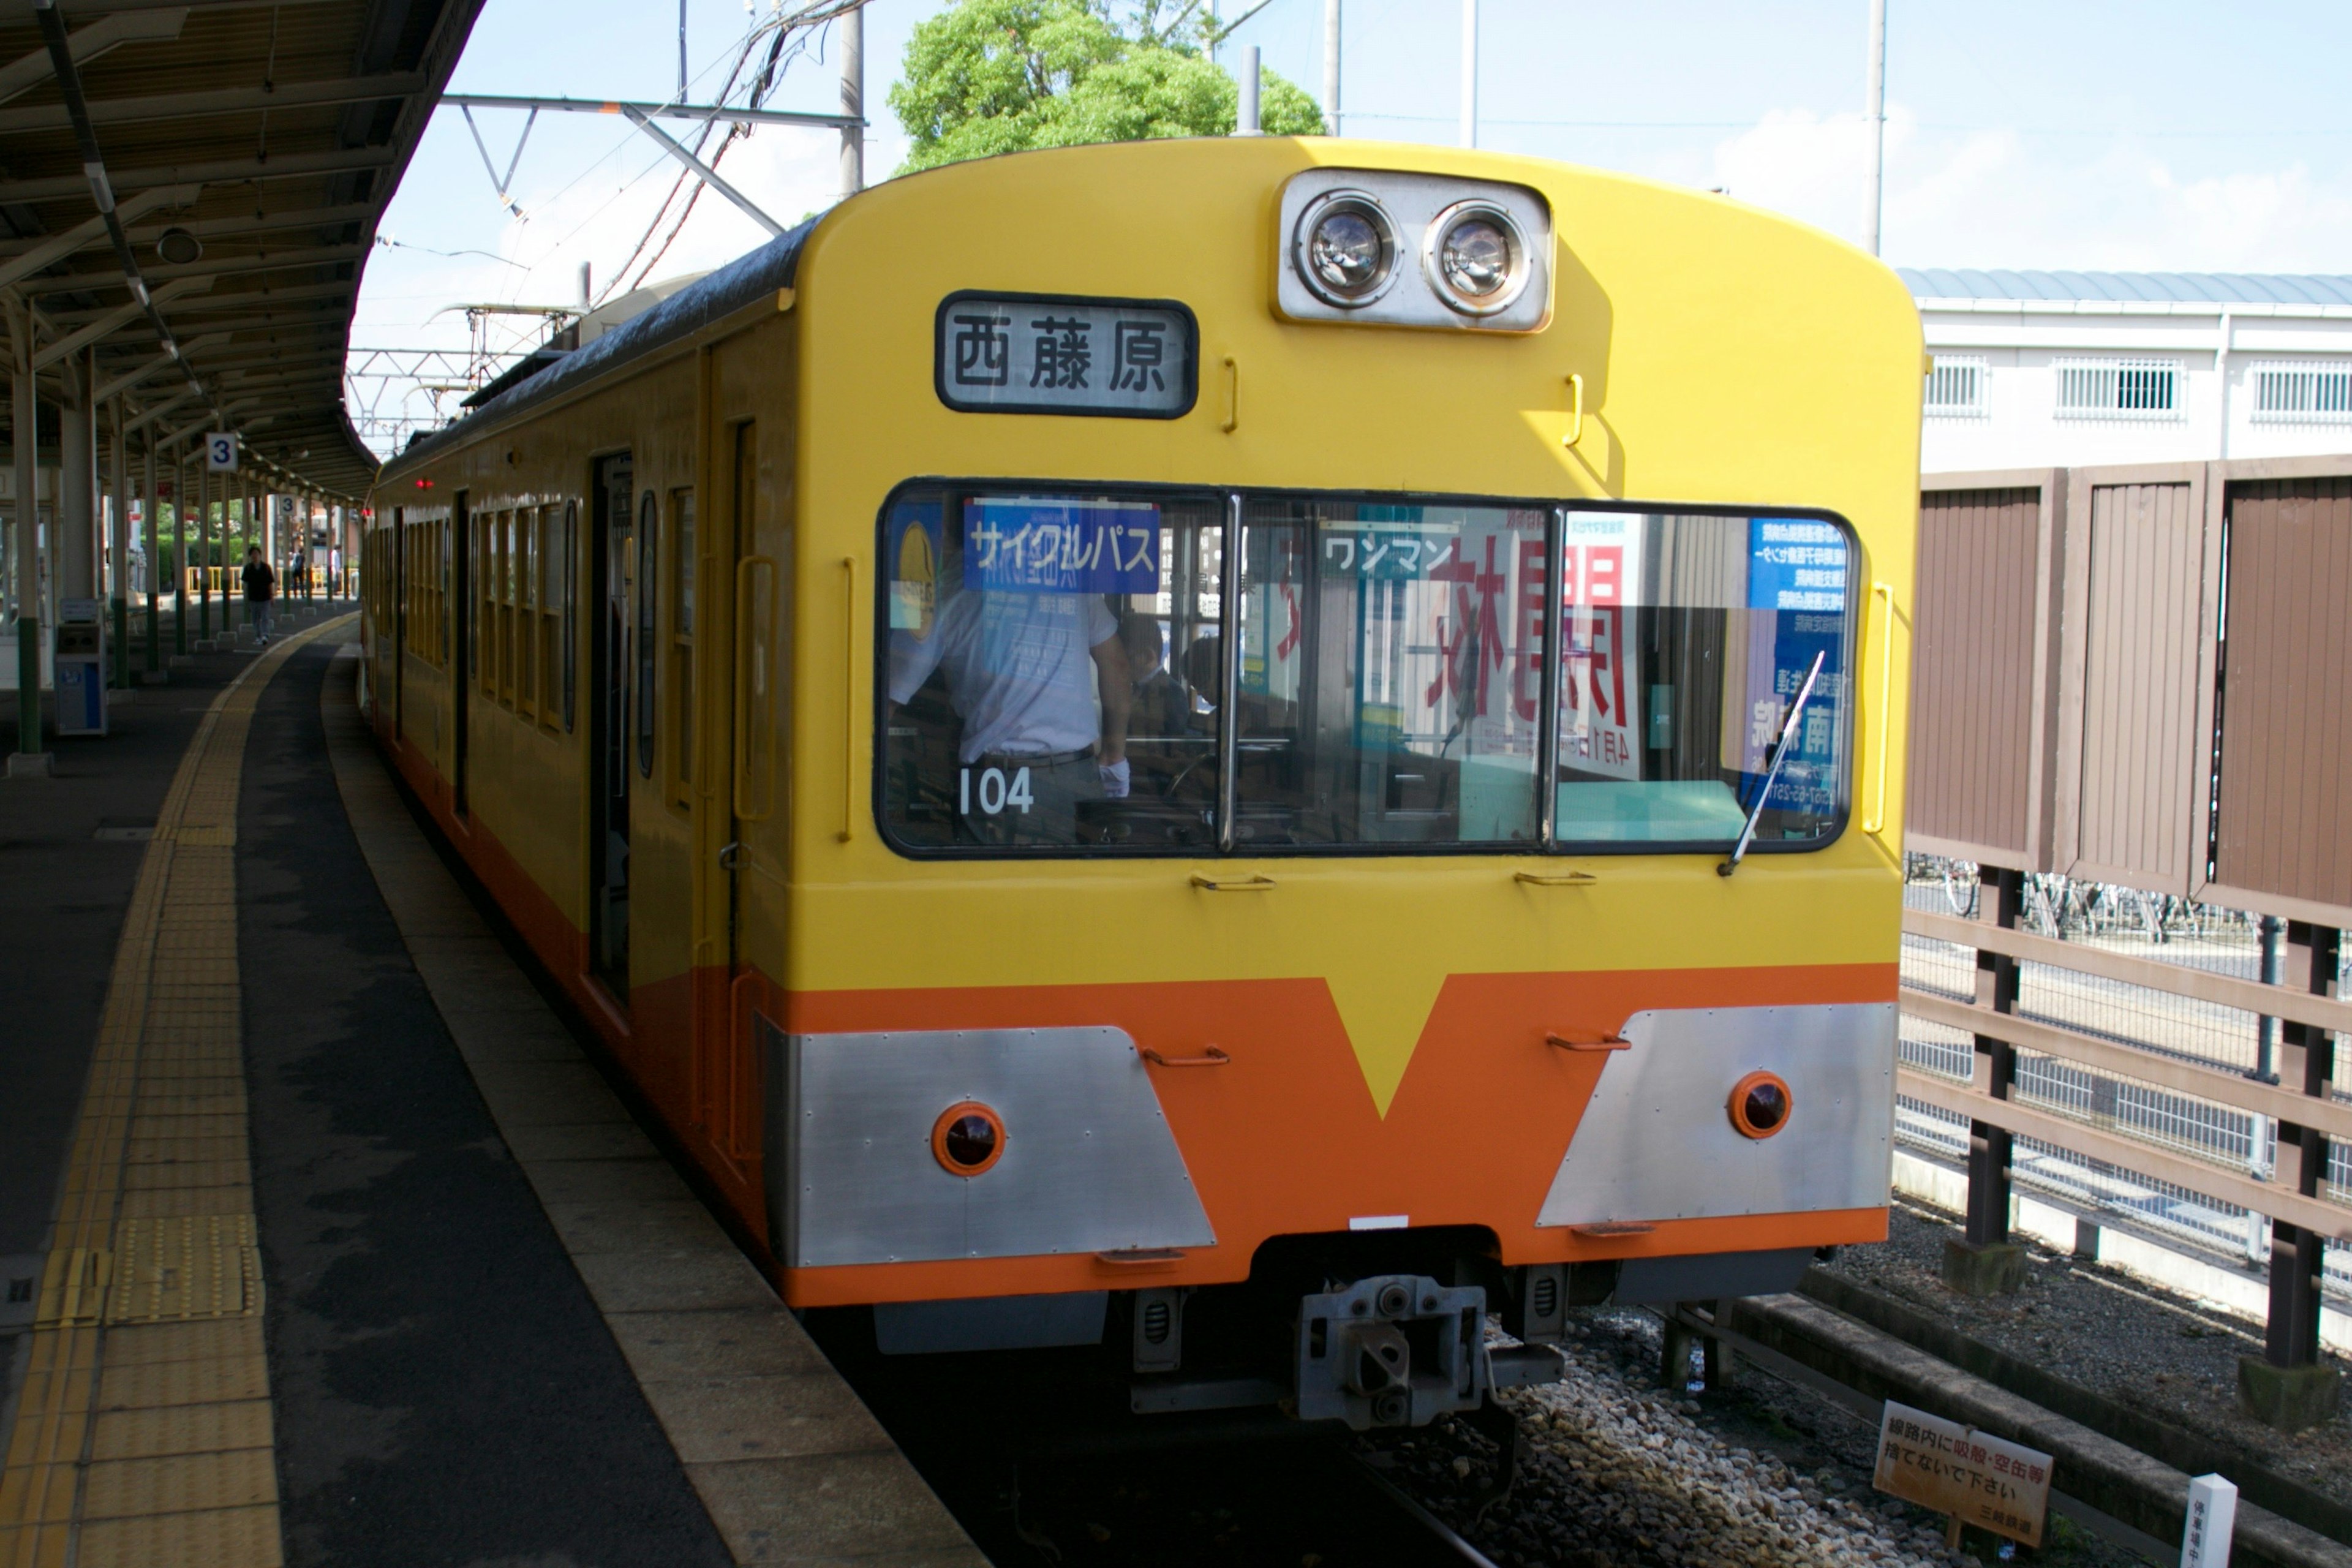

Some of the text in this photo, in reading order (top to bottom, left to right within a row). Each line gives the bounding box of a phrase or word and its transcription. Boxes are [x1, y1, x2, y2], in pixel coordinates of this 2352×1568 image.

[953, 314, 1167, 392] 西藤原
[214, 440, 230, 463] 3
[283, 497, 293, 511] 3
[970, 521, 1155, 572] サイクルパス
[1325, 537, 1453, 571] ワンマン
[960, 766, 1034, 815] 104
[1884, 1440, 2016, 1500] 捨てないで下さい
[1887, 1416, 2045, 1485] 線路内に吸殻・空缶等
[2187, 1499, 2205, 1568] 停車場中
